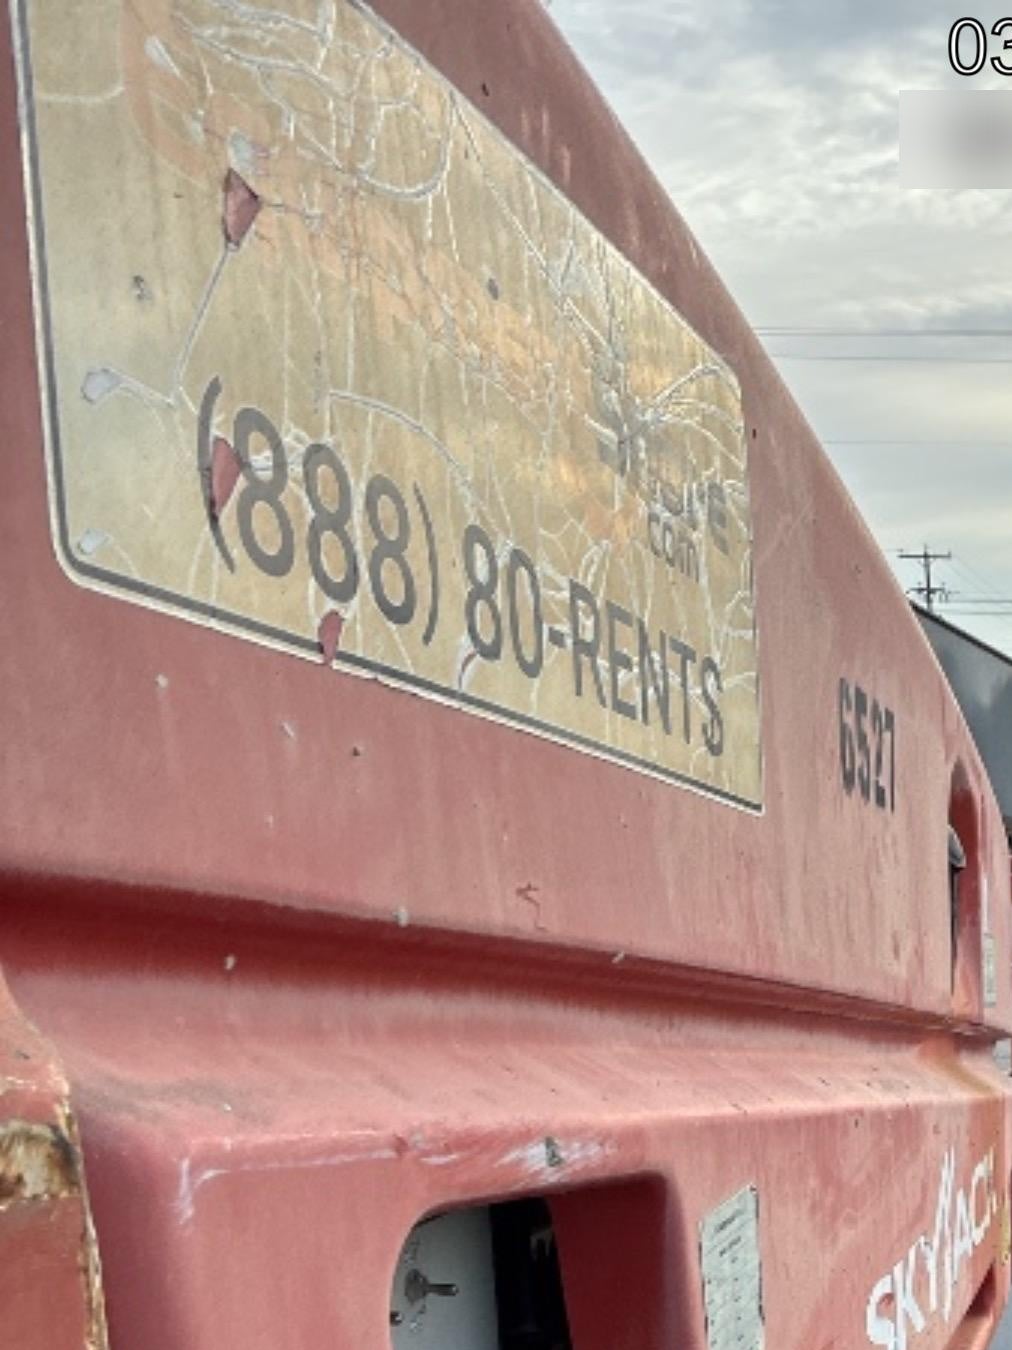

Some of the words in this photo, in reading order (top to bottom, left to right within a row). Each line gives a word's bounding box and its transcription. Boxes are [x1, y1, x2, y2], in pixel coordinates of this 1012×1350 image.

[197, 375, 438, 646] (888)
[464, 523, 724, 756] 80-RENTS
[839, 677, 895, 815] 6527
